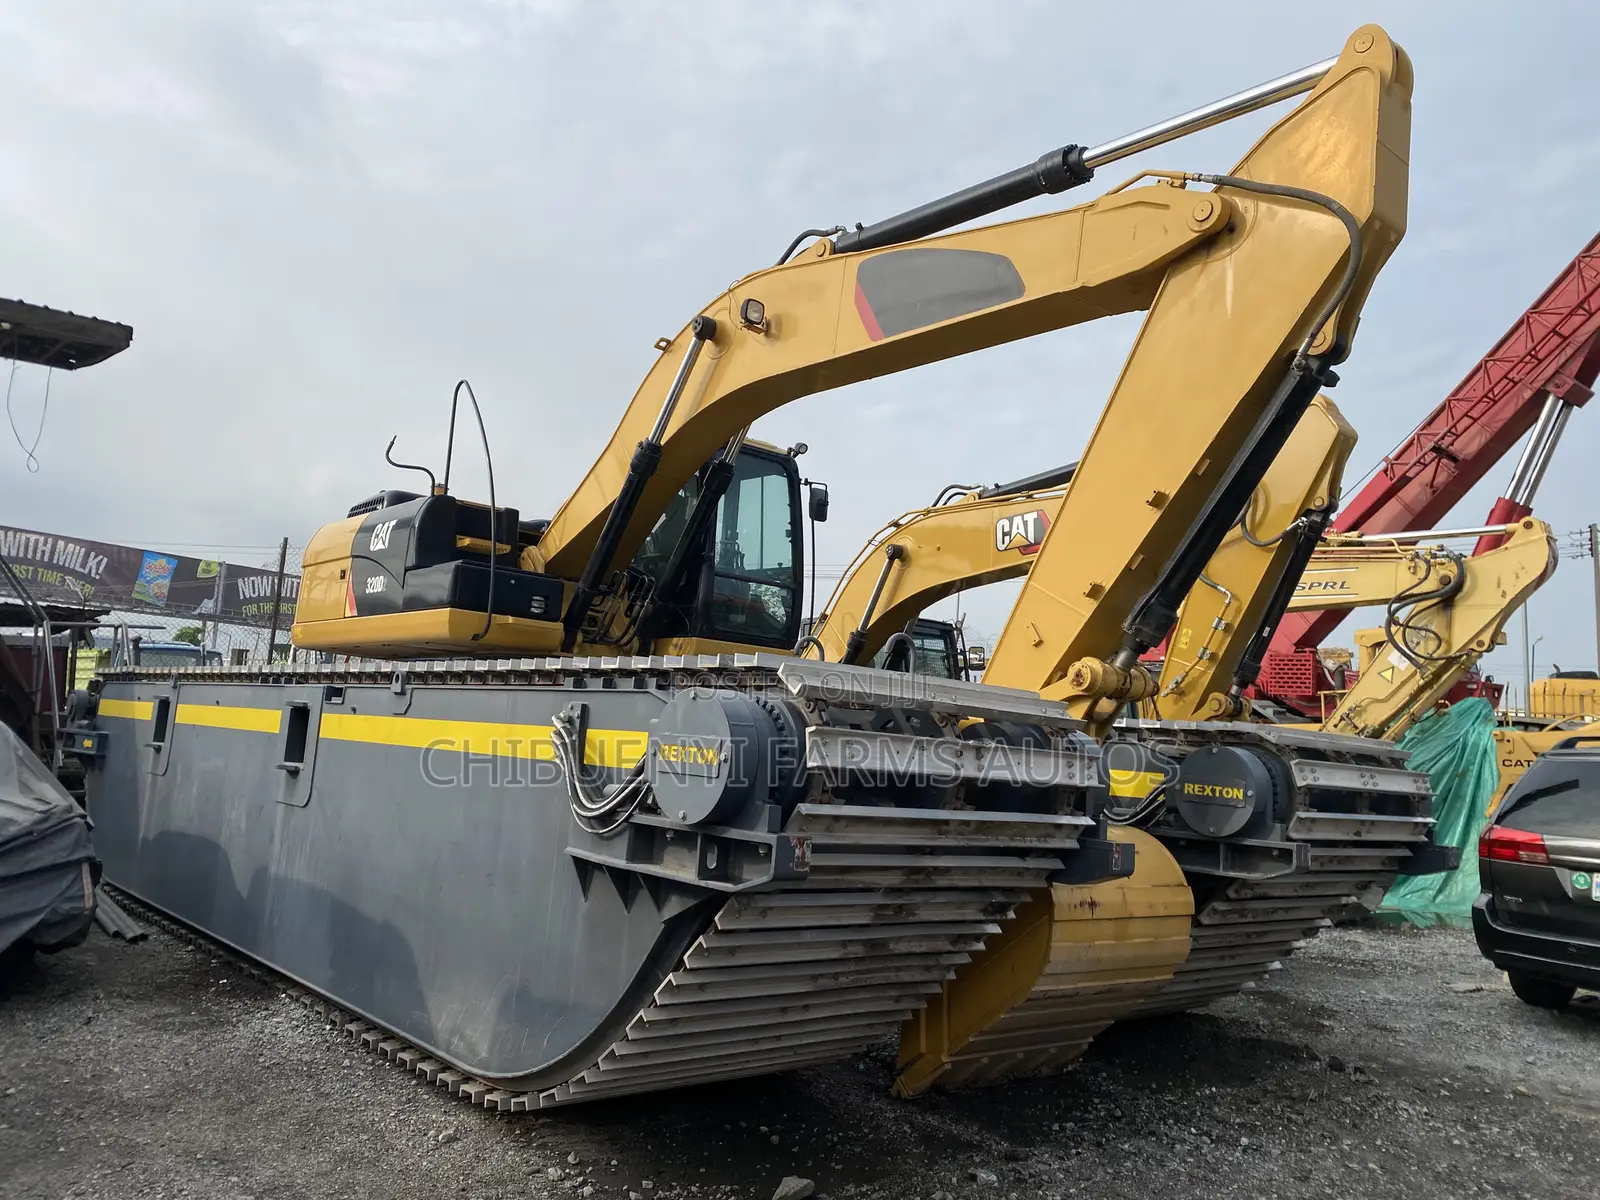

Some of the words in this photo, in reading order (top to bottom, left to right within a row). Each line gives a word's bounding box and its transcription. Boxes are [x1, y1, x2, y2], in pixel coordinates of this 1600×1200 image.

[369, 518, 398, 552] CAT
[996, 511, 1038, 551] CAT
[0, 530, 53, 563] WITH
[53, 540, 108, 580] MILK!
[37, 567, 65, 587] TIME
[238, 576, 272, 599] NOW
[241, 602, 258, 618] FOR
[278, 602, 297, 615] IRST
[658, 742, 719, 767] REXTON
[1502, 758, 1534, 769] CAT
[1183, 782, 1245, 801] REXTON
